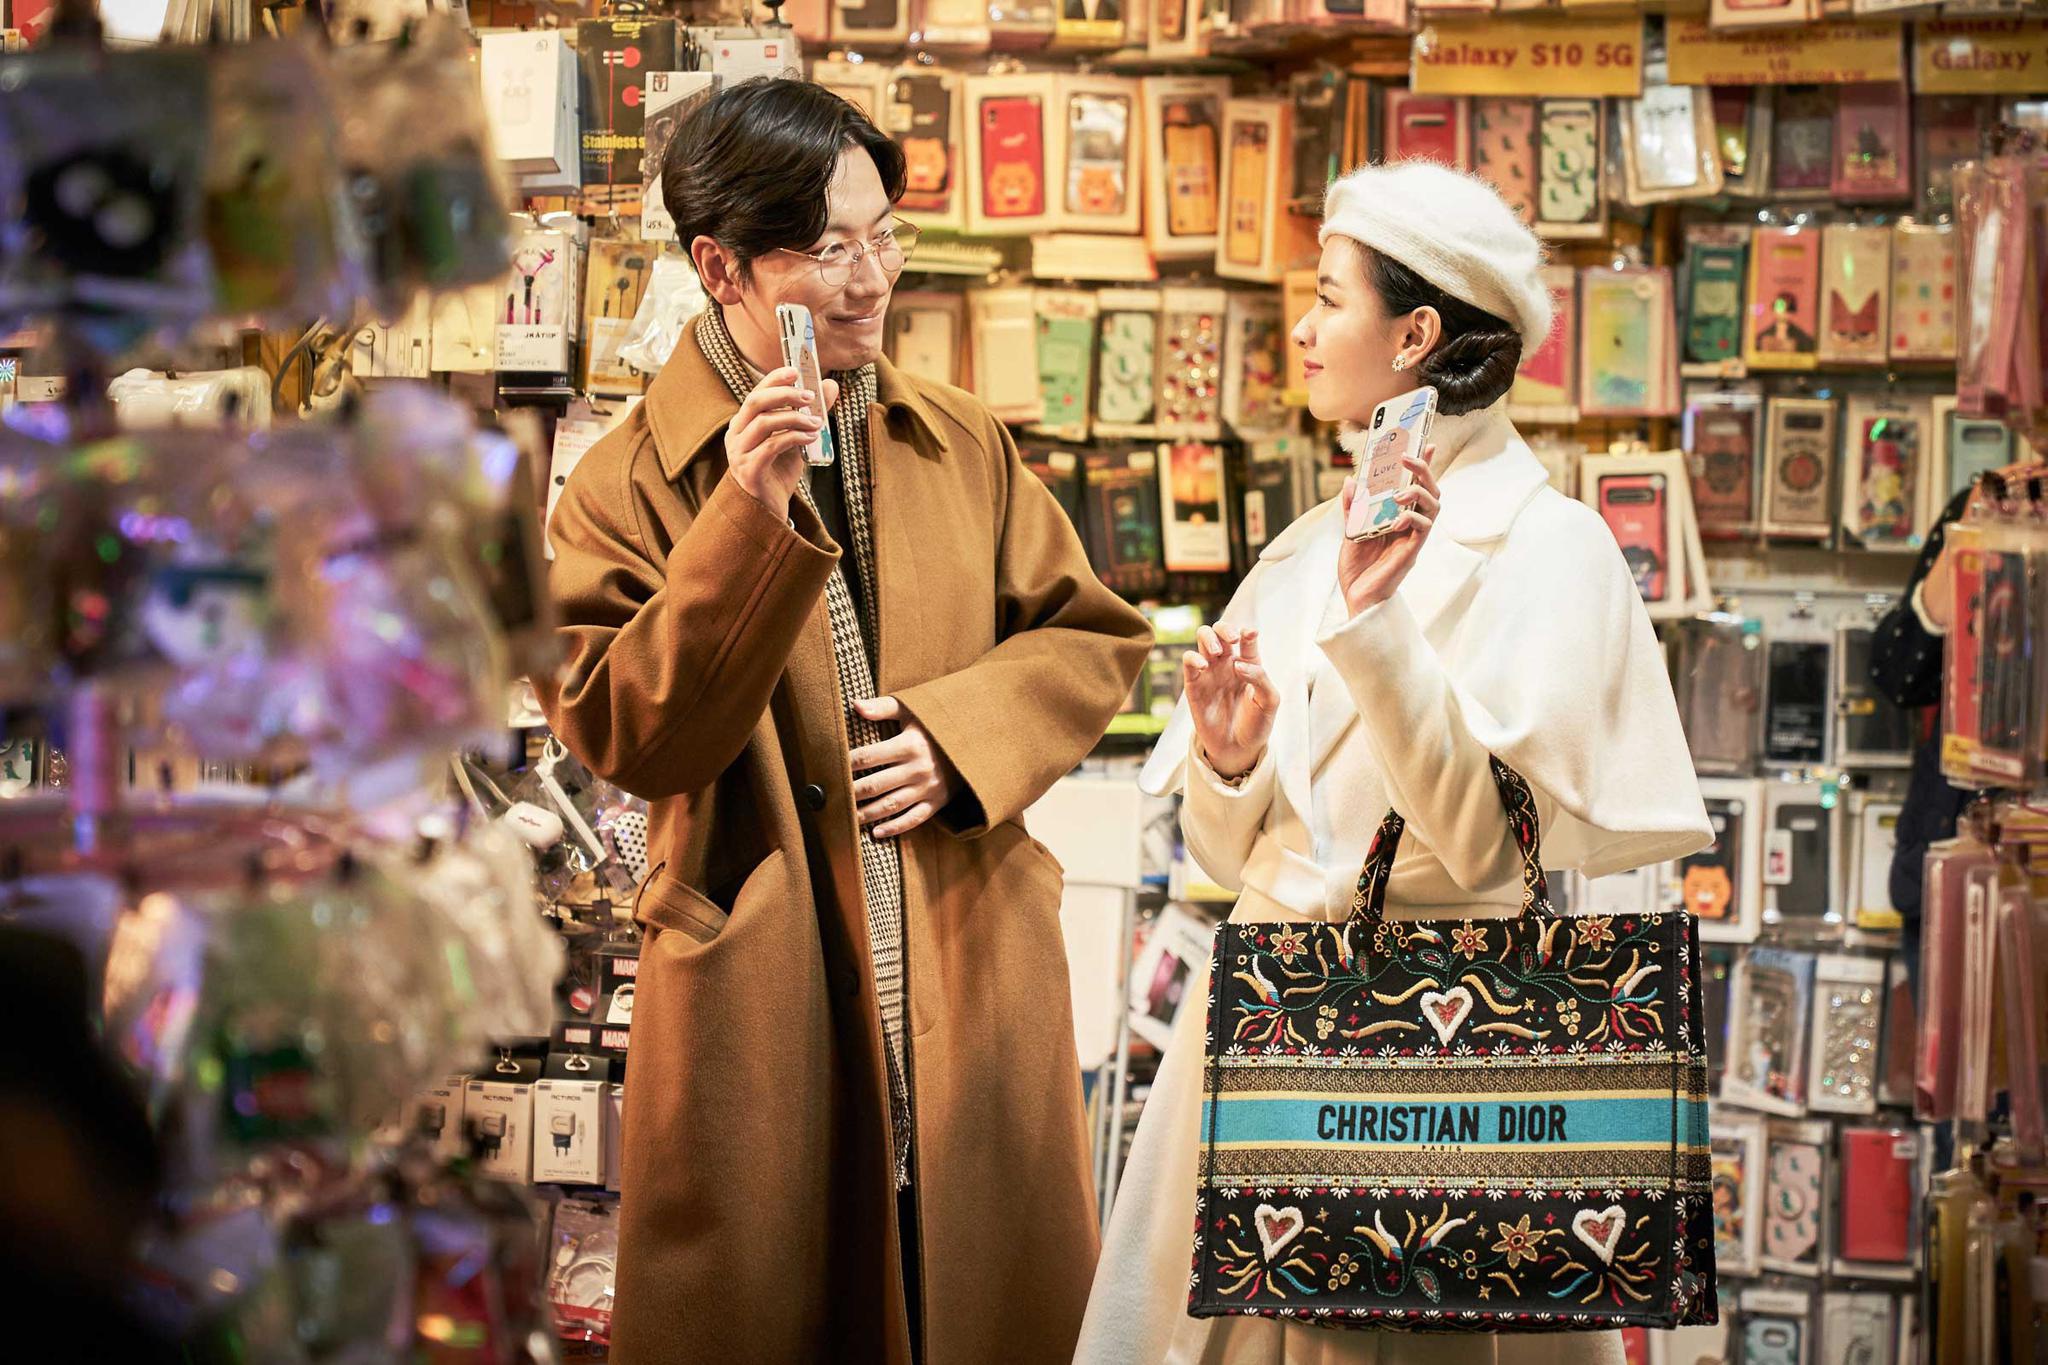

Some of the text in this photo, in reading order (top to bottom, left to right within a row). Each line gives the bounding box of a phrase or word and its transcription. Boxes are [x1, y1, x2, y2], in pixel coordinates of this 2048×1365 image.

[1420, 42, 1634, 69] Galaxy S10 5G
[1931, 43, 2032, 73] Galaxy
[582, 134, 638, 149] Stainless
[1317, 1104, 1567, 1142] CHRISTIAN DIOR
[1421, 1144, 1462, 1152] PARIS
